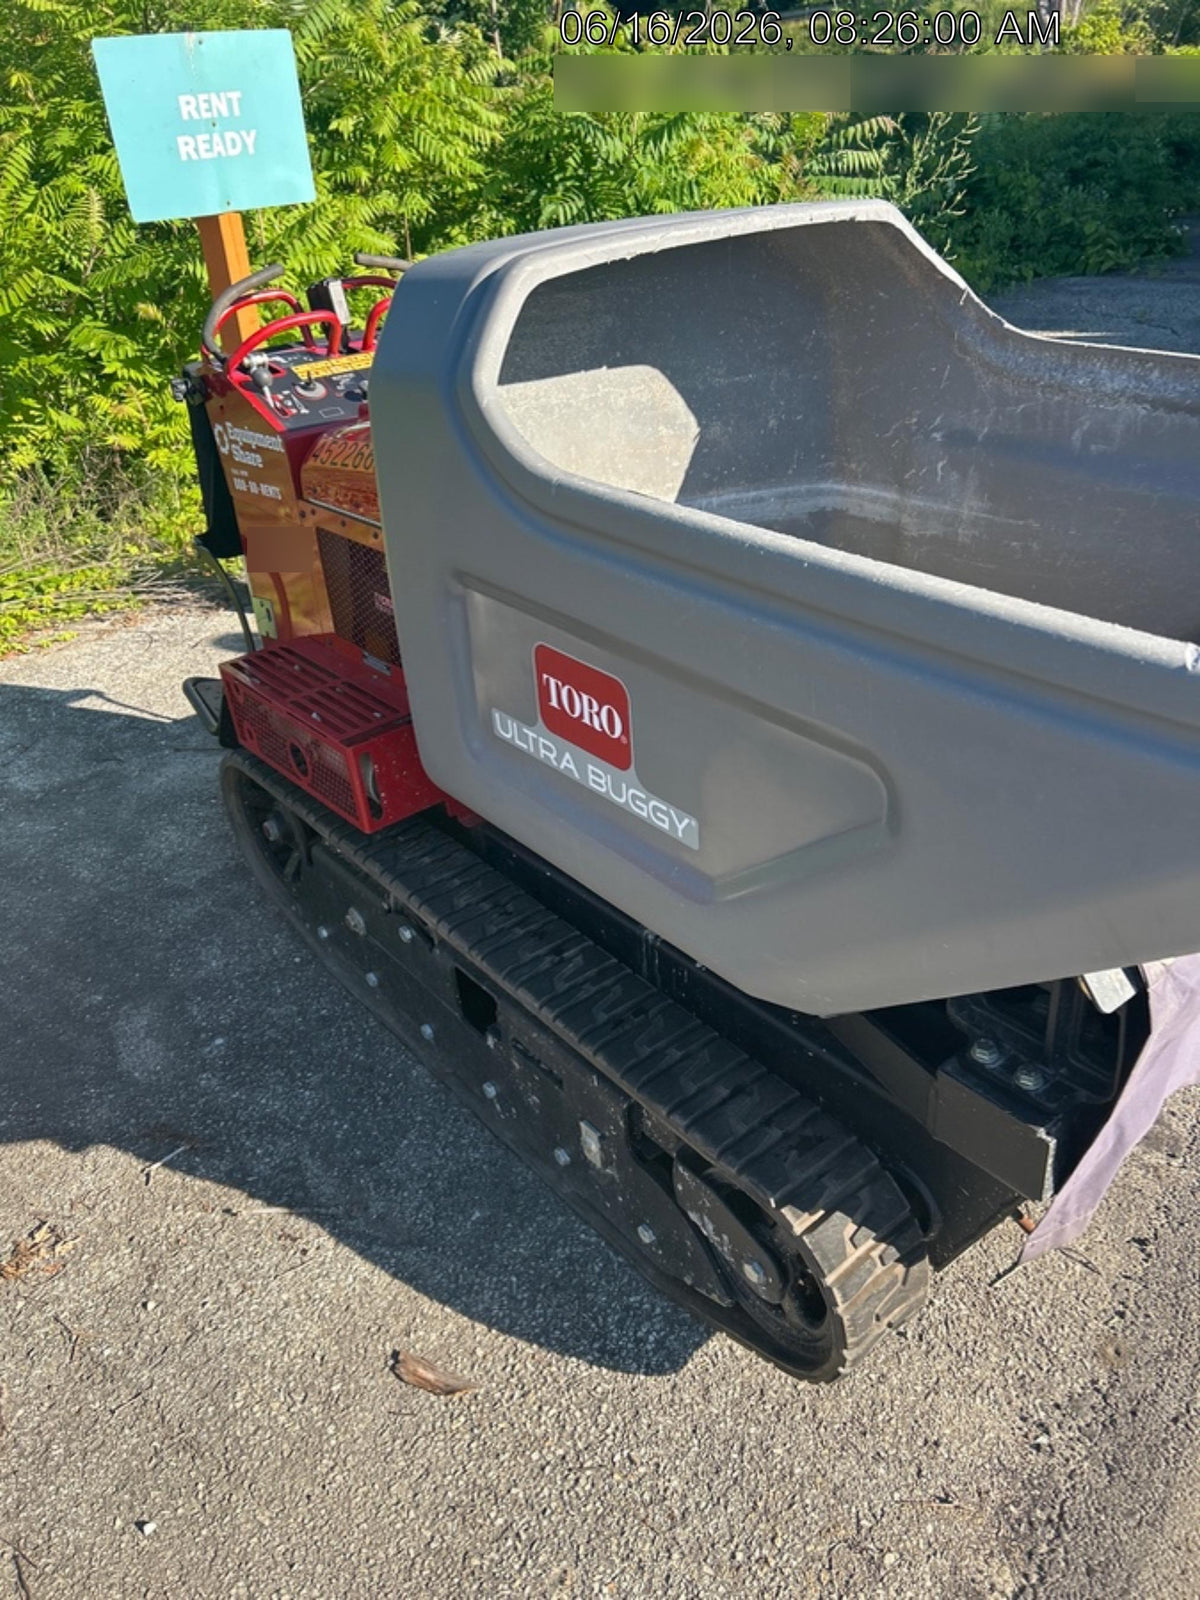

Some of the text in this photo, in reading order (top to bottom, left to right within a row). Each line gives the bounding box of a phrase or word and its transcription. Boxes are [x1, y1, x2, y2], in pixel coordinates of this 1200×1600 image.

[177, 91, 242, 120] RENT
[177, 130, 256, 160] READY
[225, 421, 285, 452] Equipment
[231, 444, 264, 468] Share
[542, 673, 623, 739] TORO
[494, 712, 691, 837] ULTRA BUGGY
